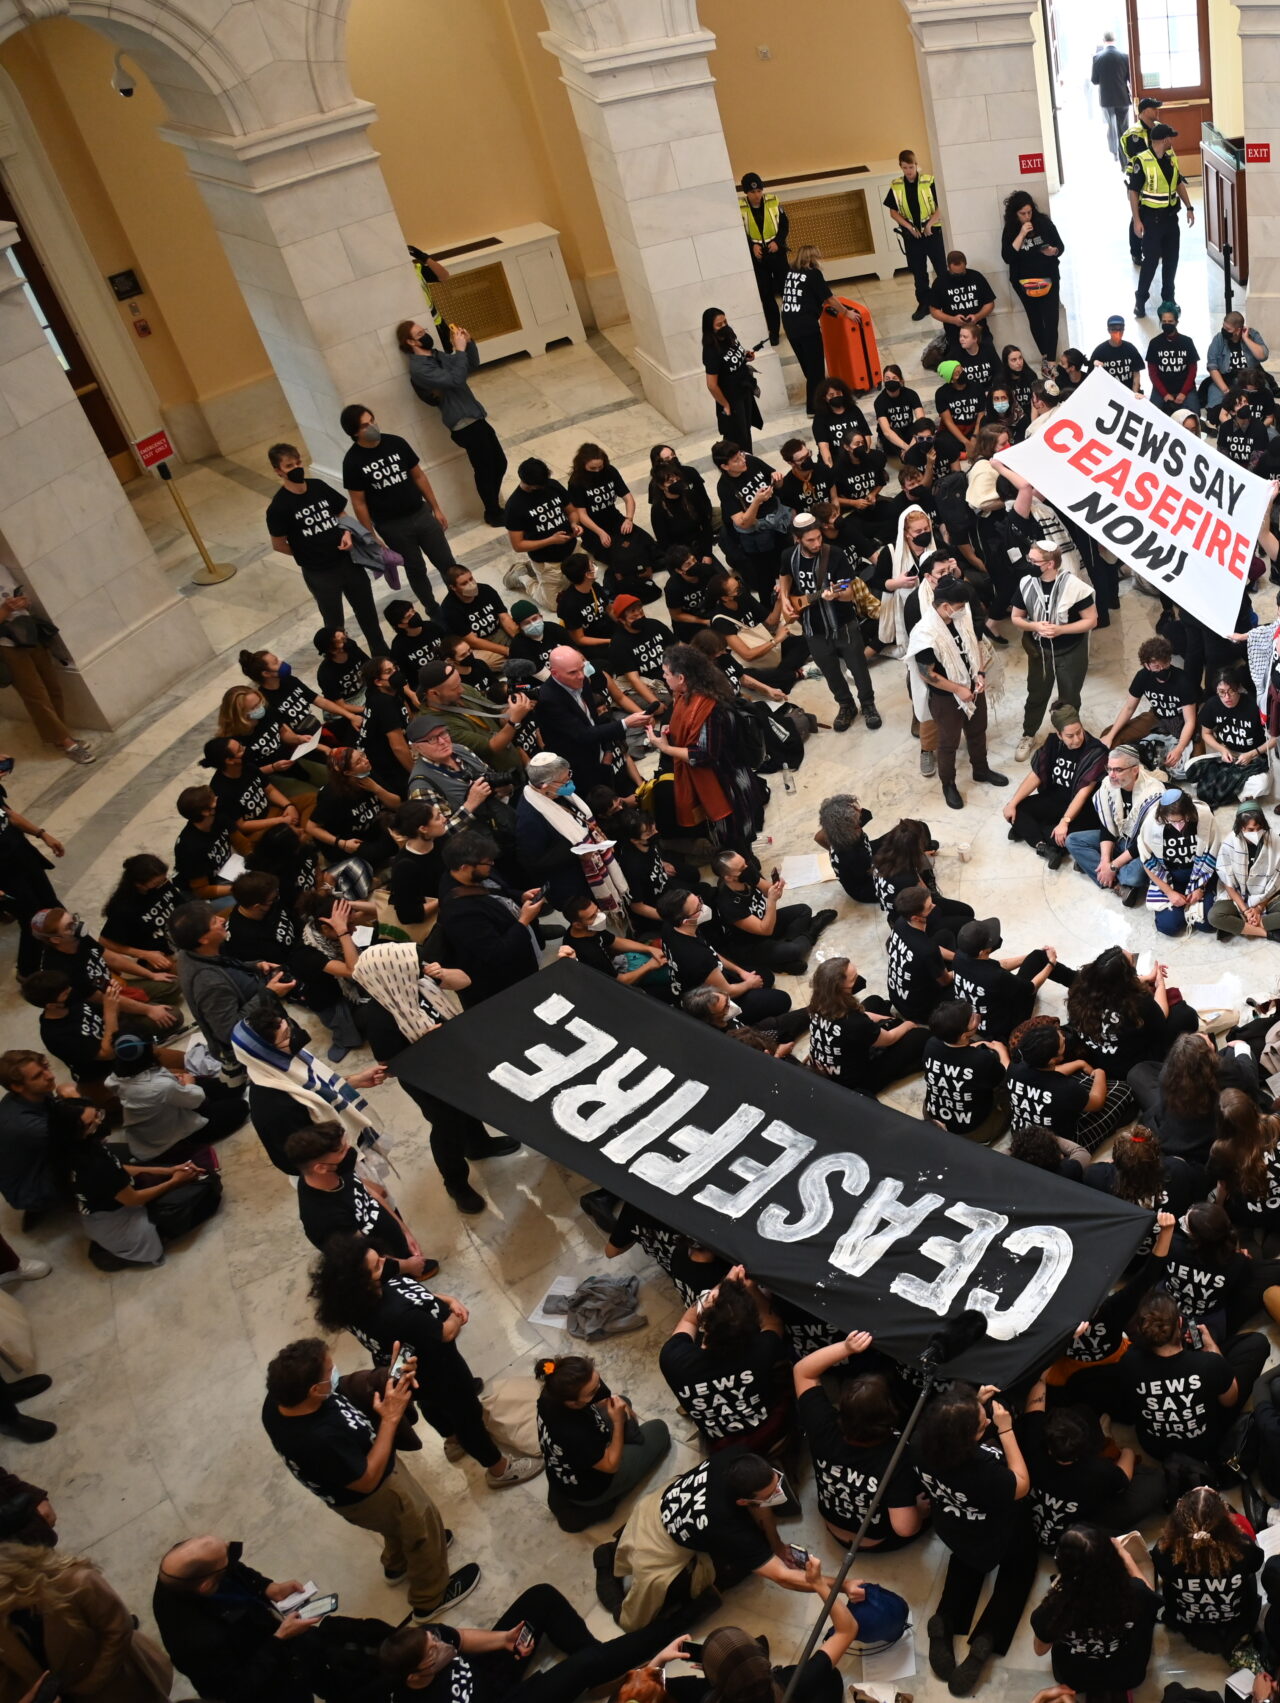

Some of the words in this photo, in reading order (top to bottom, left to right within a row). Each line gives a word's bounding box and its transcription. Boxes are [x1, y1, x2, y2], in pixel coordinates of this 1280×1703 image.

[1021, 158, 1042, 168] EXIT
[1248, 148, 1268, 159] EXIT
[951, 299, 978, 310] NAME
[954, 293, 974, 302] OUR
[362, 459, 388, 475] NOT
[388, 454, 400, 464] IN
[1096, 400, 1188, 477] JEWS
[1189, 452, 1246, 516] SAY
[372, 471, 408, 490] NAME
[373, 464, 401, 480] OUR
[529, 503, 548, 518] NOT
[552, 497, 561, 505] IN
[1042, 418, 1250, 580] CEASEFIRE
[296, 505, 318, 521] NOT
[318, 500, 329, 508] IN
[303, 509, 332, 527] OUR
[538, 507, 562, 522] OUR
[1082, 492, 1188, 582] NOW!
[633, 641, 650, 655] NOT
[653, 634, 662, 643] IN
[639, 646, 663, 661] OUR
[640, 654, 663, 672] NAM
[293, 687, 303, 697] IN
[287, 696, 307, 716] OUR
[1240, 720, 1251, 728] IN
[251, 732, 270, 750] NOT
[142, 902, 164, 923] NOT
[926, 1058, 973, 1079] JEWS
[928, 1072, 964, 1091] SAY
[1008, 1079, 1052, 1104] JEWS
[927, 1103, 972, 1121] NOW
[930, 1095, 963, 1110] FIRE
[1011, 1093, 1047, 1115] SAY
[354, 1188, 362, 1221] NOT
[1167, 1262, 1225, 1289] JEWS
[679, 1370, 754, 1400] JEWS
[1137, 1375, 1201, 1394] JEWS
[692, 1386, 746, 1410] SAY
[1147, 1393, 1194, 1410] SAY
[1142, 1404, 1205, 1421] CEASE
[1153, 1419, 1197, 1432] FIRE
[694, 1461, 709, 1530] JEWS
[1174, 1574, 1241, 1592] JEWS
